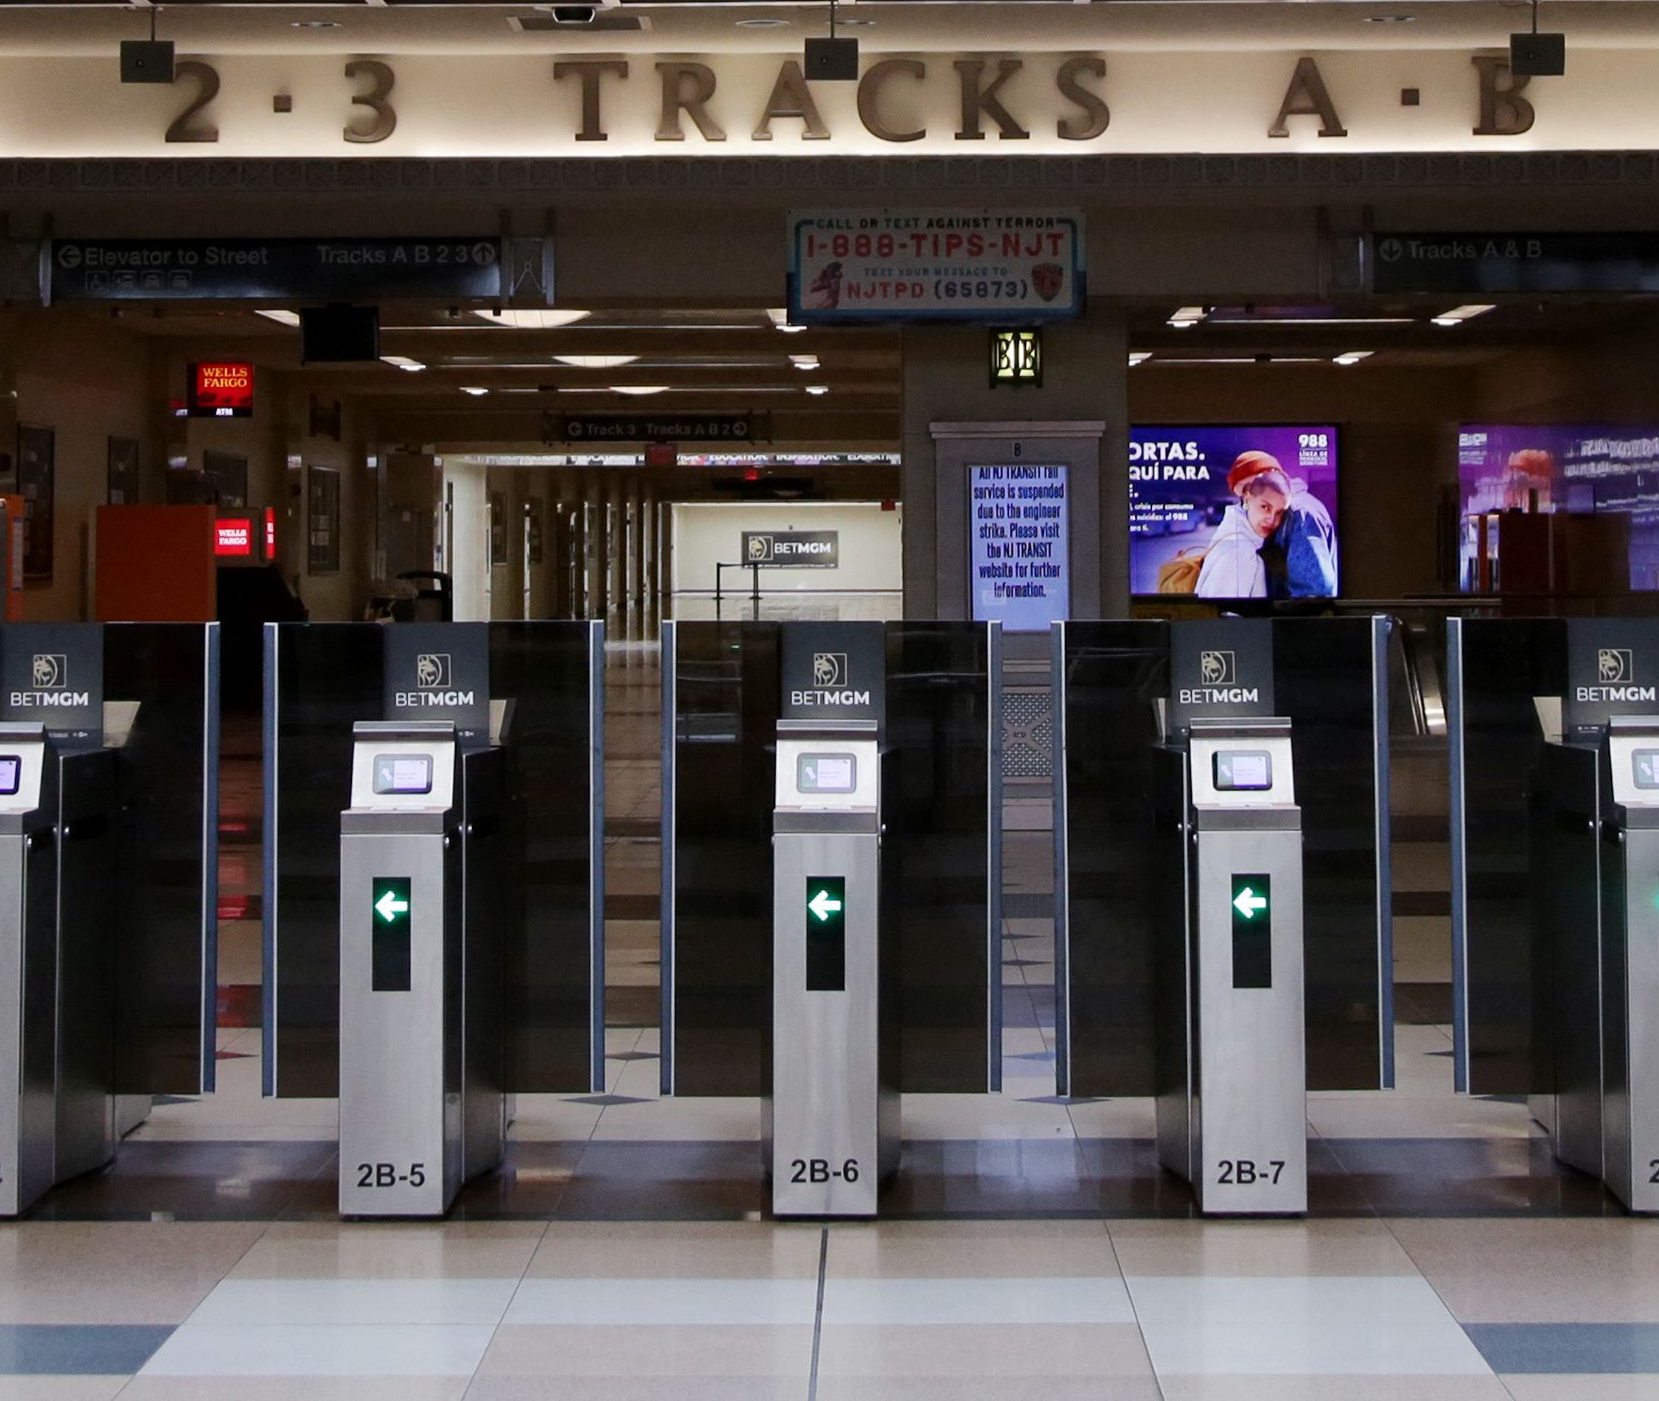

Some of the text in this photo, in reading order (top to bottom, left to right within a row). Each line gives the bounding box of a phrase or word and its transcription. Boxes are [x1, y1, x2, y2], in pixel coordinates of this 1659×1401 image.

[552, 57, 1112, 143] TRACKS
[817, 217, 1055, 229] CALL OR TEXT AGAINST TERROR
[85, 247, 269, 267] Elevator to Street
[317, 246, 469, 265] Tracks A B 2 3
[1407, 239, 1543, 260] Tracks A & B
[899, 266, 930, 277] YOUR
[993, 267, 1008, 276] TO
[847, 281, 1029, 300] NJTPD (65873)
[203, 368, 248, 377] WELLS
[204, 378, 247, 388] FARGO
[215, 408, 234, 417] ATM
[1298, 434, 1329, 448] 988
[993, 467, 1004, 480] NJ
[1006, 467, 1042, 480] TRANSIT
[1163, 466, 1210, 480] PARA
[973, 483, 1065, 501] service is suspended
[977, 503, 1062, 521] due to the engineer
[218, 529, 247, 537] WELLS
[979, 523, 1060, 539] strike. Please visit
[218, 537, 247, 546] FARGO
[774, 542, 832, 554] BETMGM
[987, 542, 1053, 559] the NJ TRANSIT
[979, 562, 1061, 579] website for further
[994, 581, 1047, 599] information.
[10, 690, 89, 707] BETMGM
[395, 690, 474, 707] BETMGM
[791, 689, 870, 706] BETMGM
[1179, 687, 1258, 704] BETMGM
[1576, 685, 1656, 702] BETMGM
[357, 1163, 426, 1188] 2B-5
[790, 1158, 859, 1184] 2B-6
[1217, 1160, 1286, 1185] 2B-7
